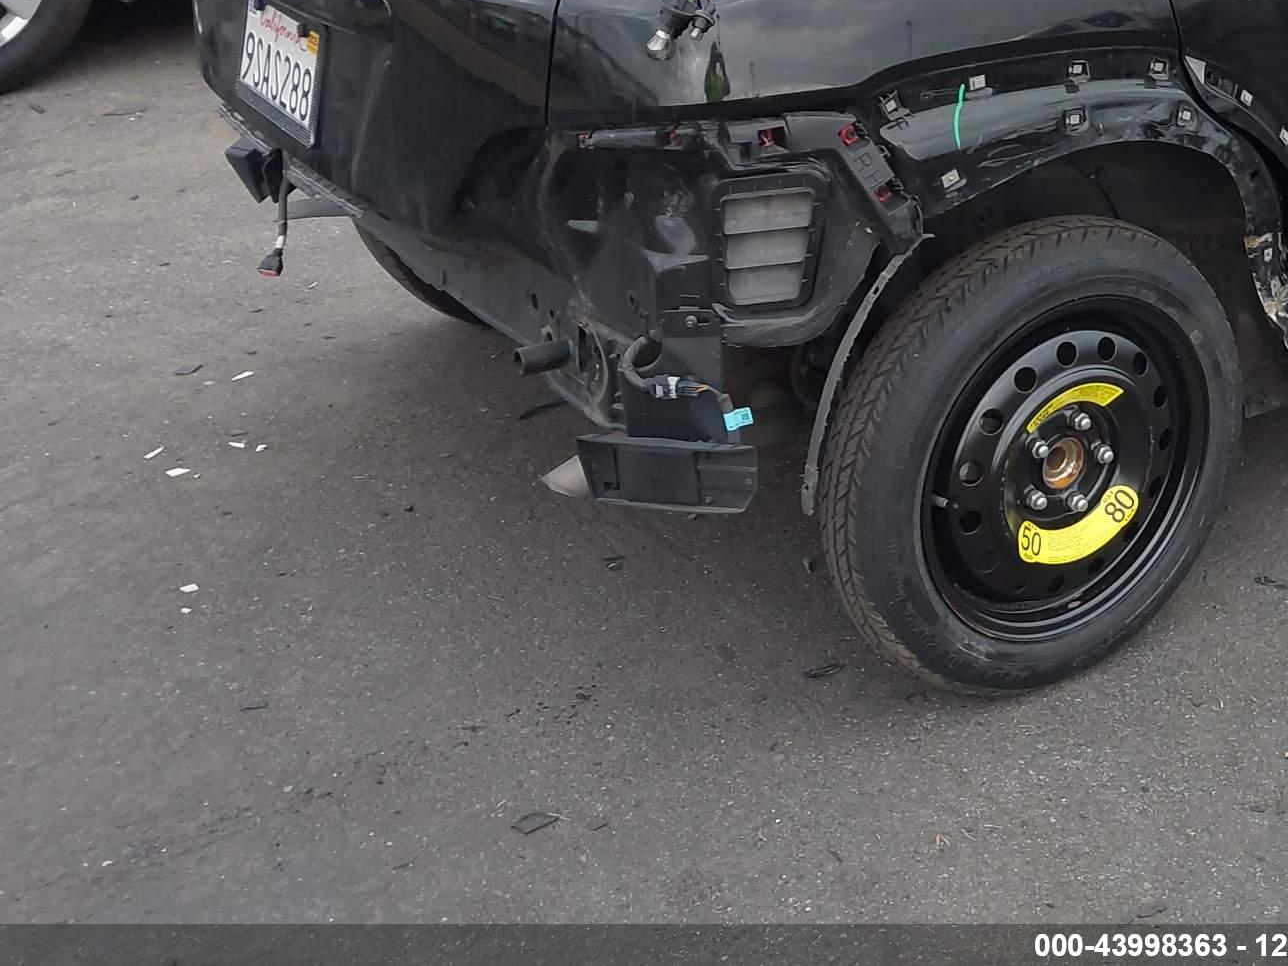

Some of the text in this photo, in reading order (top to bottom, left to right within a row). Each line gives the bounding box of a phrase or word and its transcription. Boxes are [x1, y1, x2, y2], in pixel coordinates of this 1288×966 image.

[242, 31, 313, 121] 9SAS288
[1104, 489, 1135, 523] 80
[1021, 524, 1042, 557] 50
